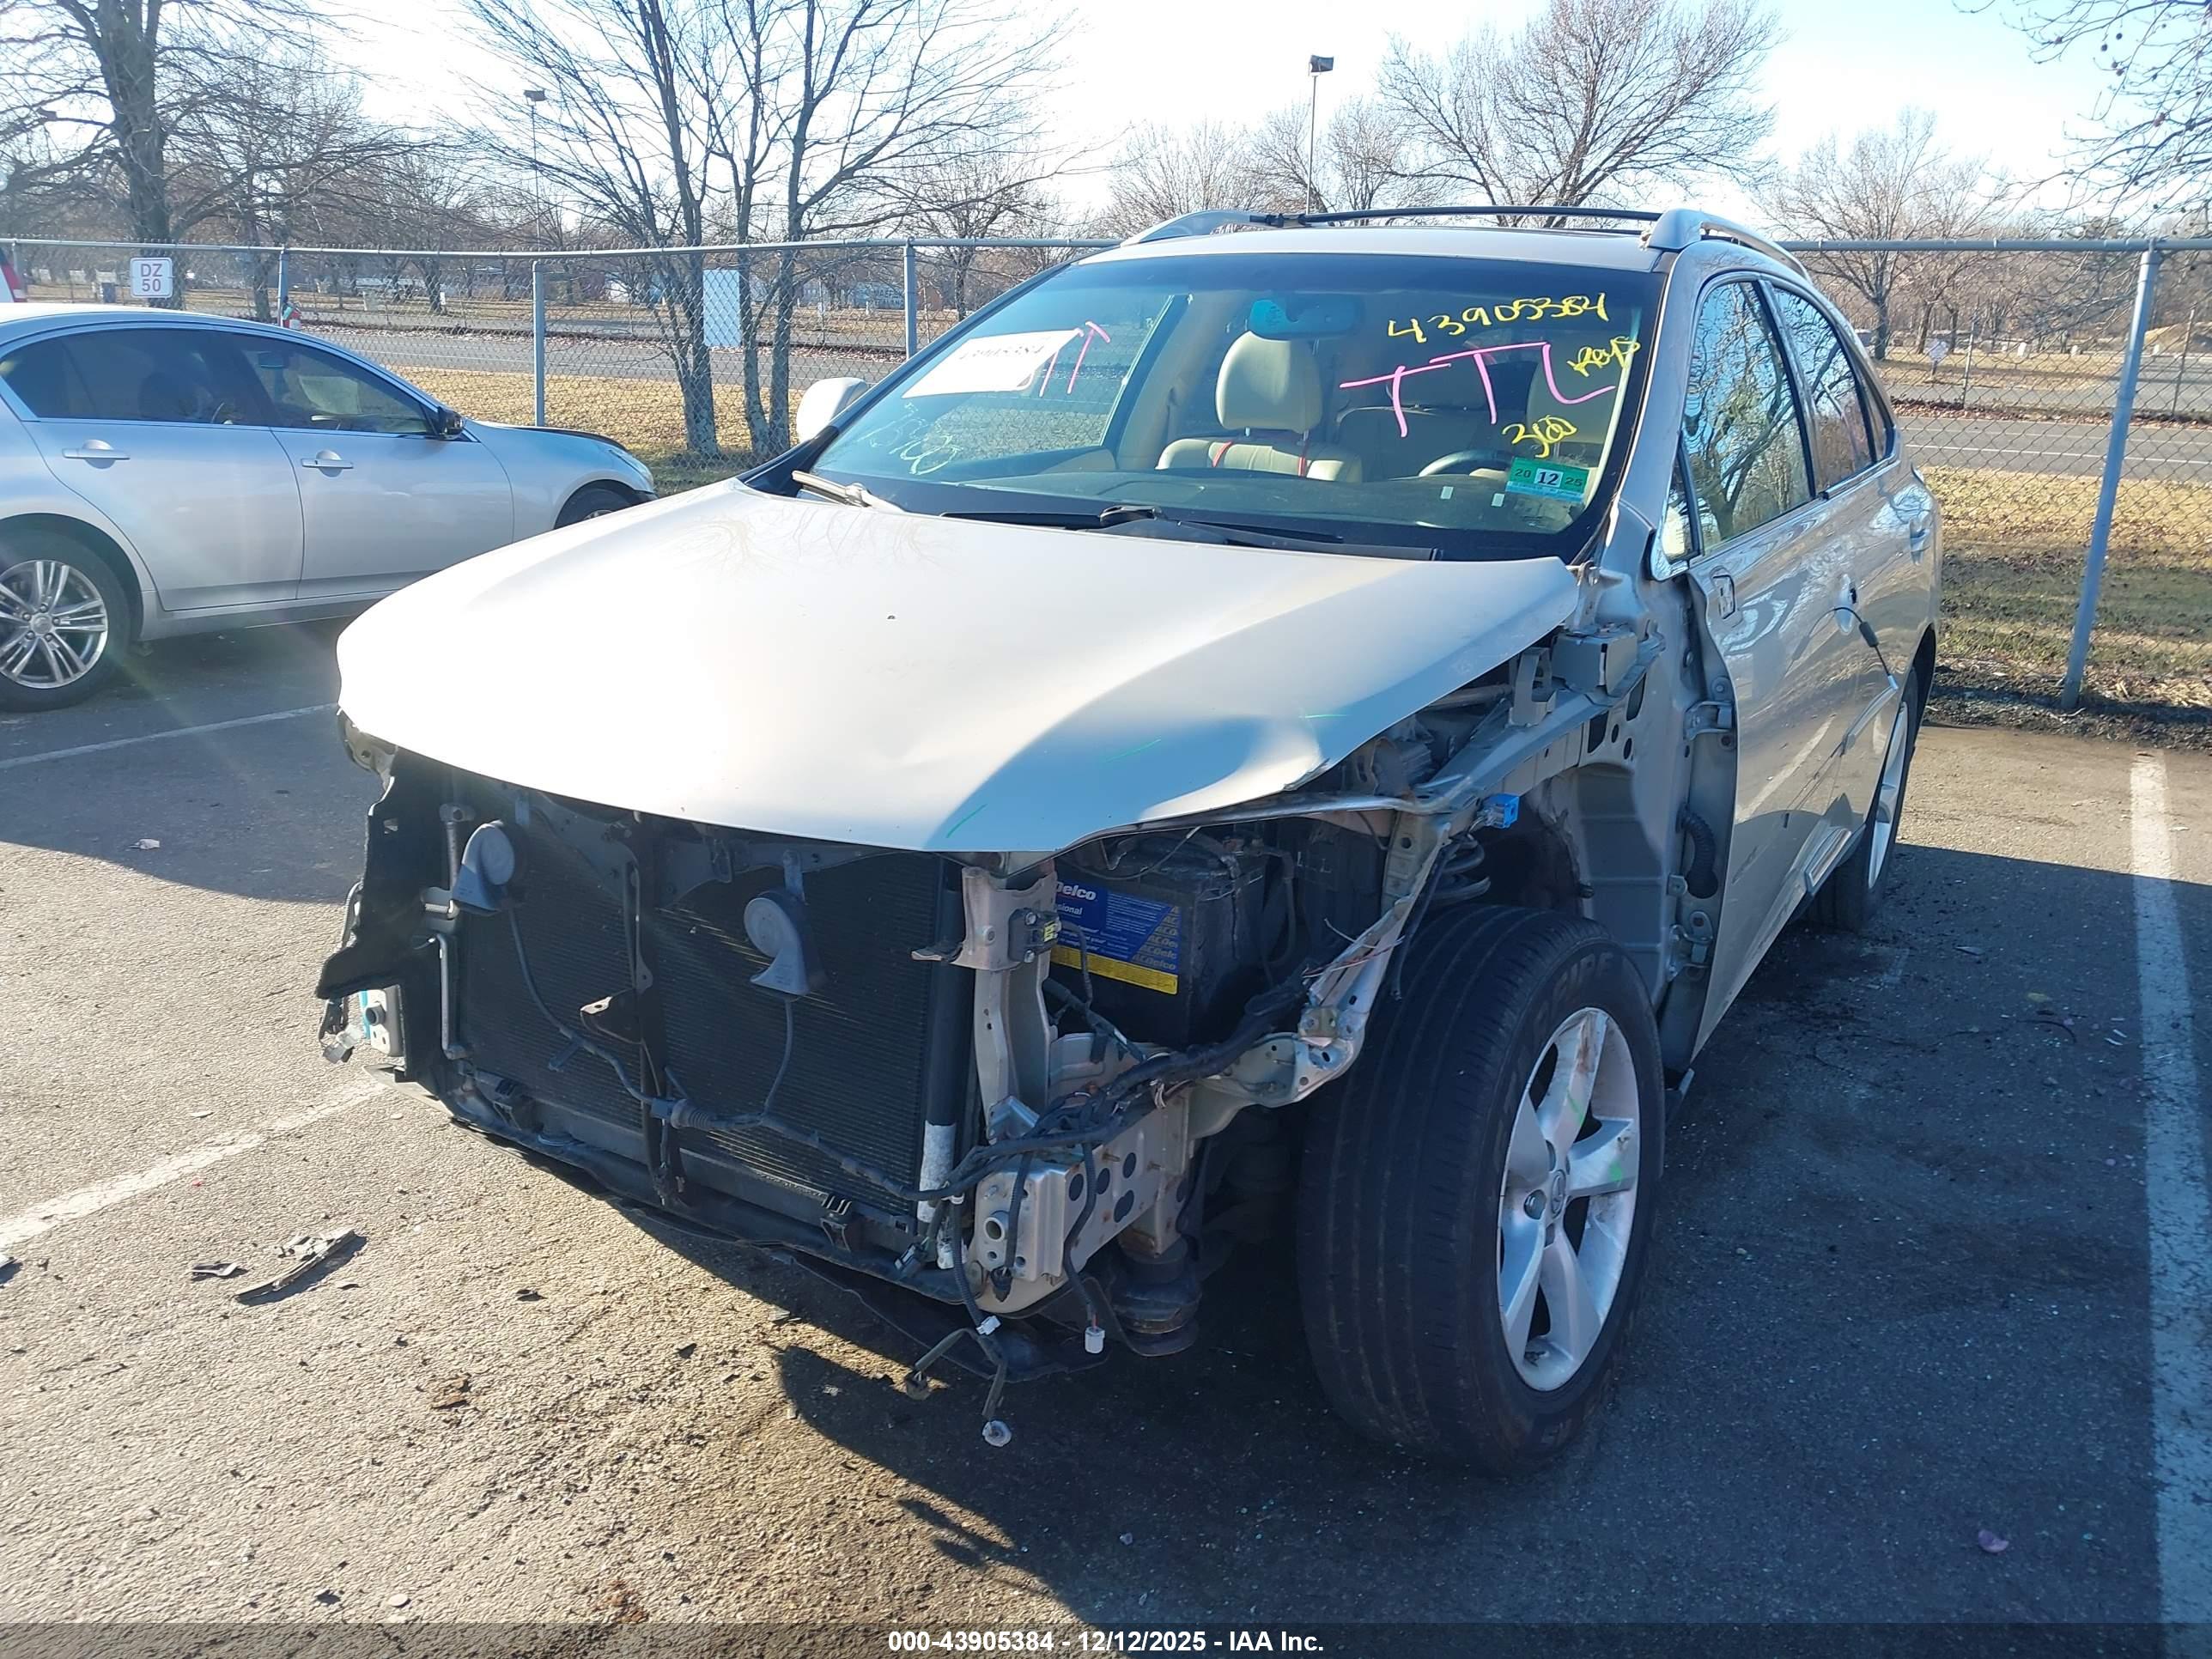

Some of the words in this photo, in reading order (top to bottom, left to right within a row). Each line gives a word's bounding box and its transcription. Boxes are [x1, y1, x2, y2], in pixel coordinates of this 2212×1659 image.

[140, 263, 163, 277] DZ
[142, 278, 161, 292] 50
[1387, 292, 1610, 343] 43905384
[1340, 341, 1616, 438] TTL
[1514, 468, 1532, 478] 20
[1537, 471, 1559, 486] 12
[1565, 477, 1583, 487] 25
